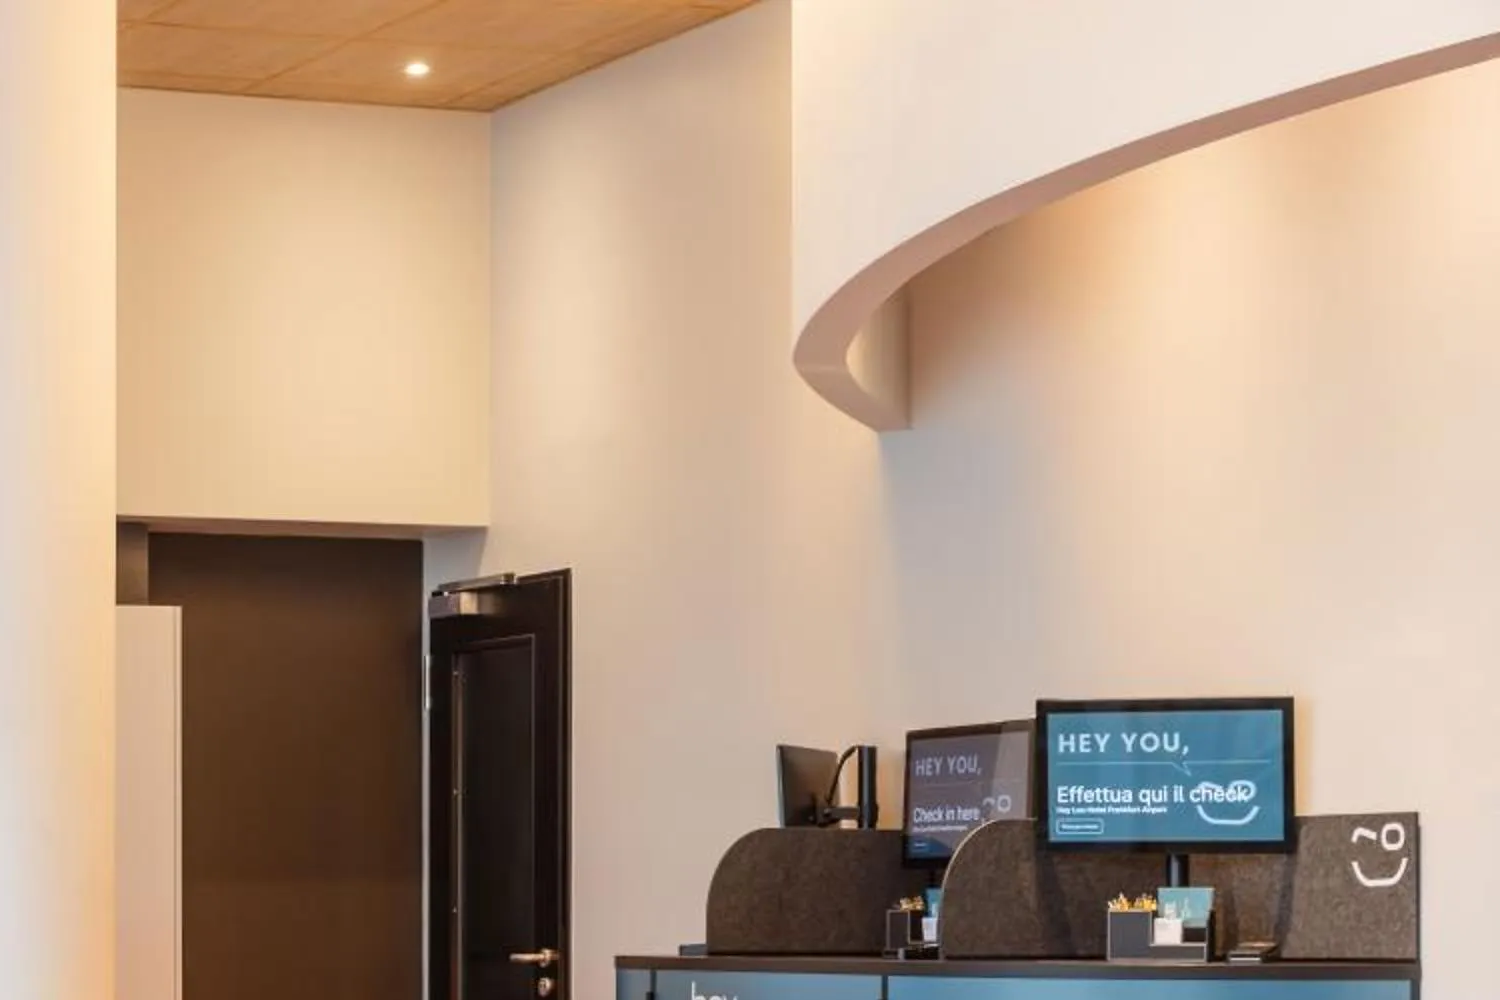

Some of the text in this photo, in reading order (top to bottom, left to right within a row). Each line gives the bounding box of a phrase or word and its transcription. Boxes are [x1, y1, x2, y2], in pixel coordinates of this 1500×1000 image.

[1057, 731, 1189, 755] HEY YOU,
[915, 754, 983, 777] HEY YOU,
[1056, 785, 1133, 804] Effettua
[1138, 785, 1168, 808] qui
[1173, 784, 1185, 803] il
[913, 806, 943, 824] Check
